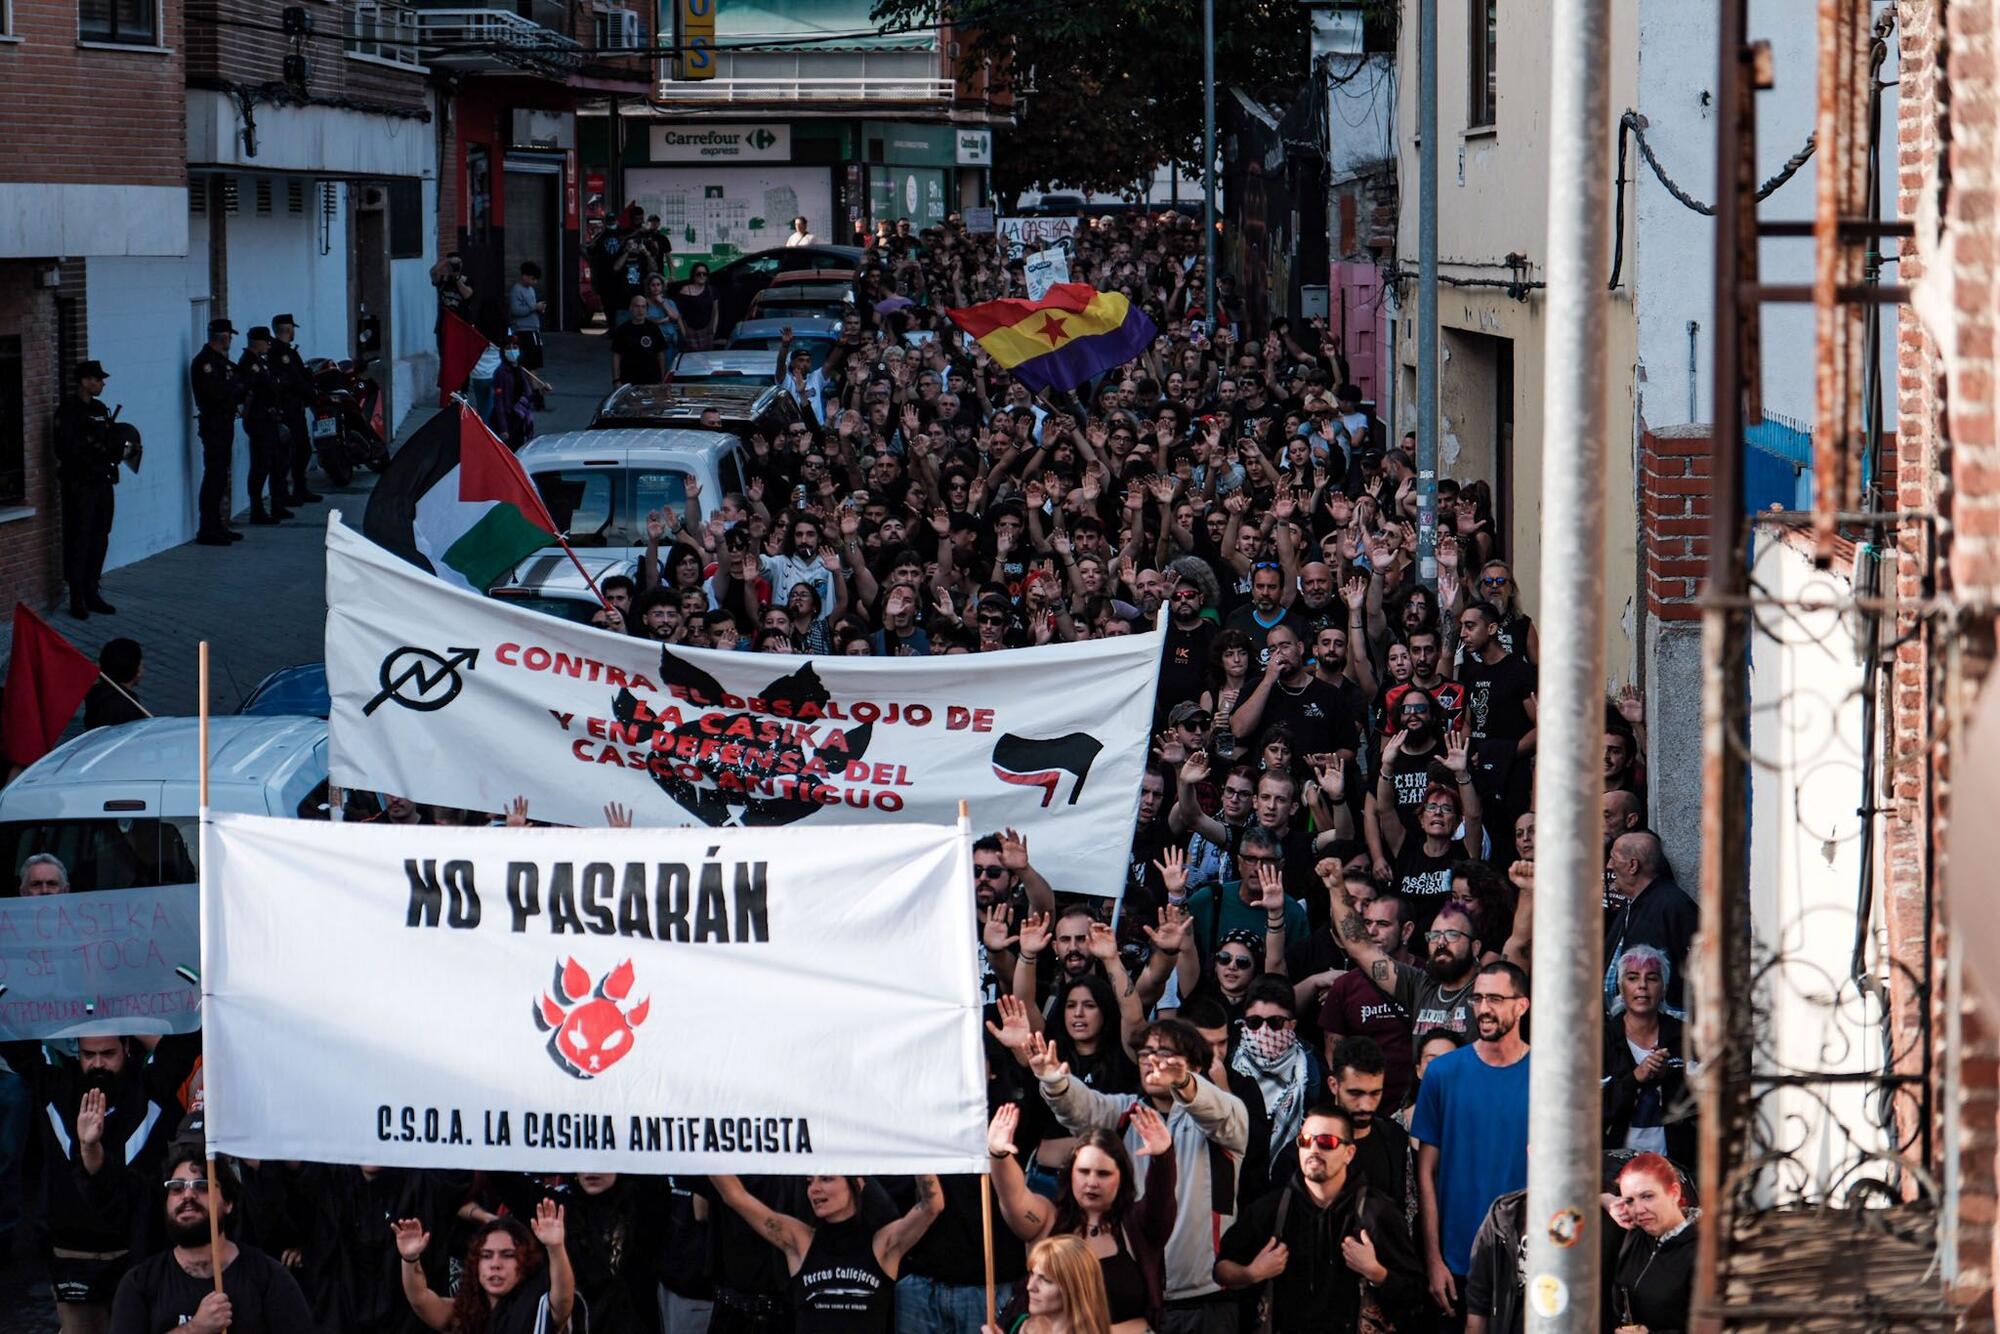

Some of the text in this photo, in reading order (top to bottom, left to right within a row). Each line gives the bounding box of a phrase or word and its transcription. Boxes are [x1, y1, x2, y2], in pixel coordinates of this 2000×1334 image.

[665, 131, 740, 145] Carrefour
[700, 147, 739, 157] express
[1021, 218, 1071, 241] CASIKA
[495, 642, 996, 733] CONTRA EL DESALOJO DE
[632, 699, 850, 753] LA CASIKA
[548, 709, 914, 786] Y EN DEFENSA DEL
[572, 738, 905, 812] CASCO ANTIGUO
[403, 845, 770, 944] NO PASARÁN
[1401, 876, 1441, 889] ASCIST
[0, 901, 172, 941] A CASIKA
[26, 948, 58, 977] SE
[72, 937, 166, 976] TOCA
[96, 990, 197, 1017] ANTIFASCISTA
[376, 1104, 473, 1146] C.S.O.A.
[484, 1110, 512, 1147] LA
[802, 1266, 881, 1289] Perras Callejeras
